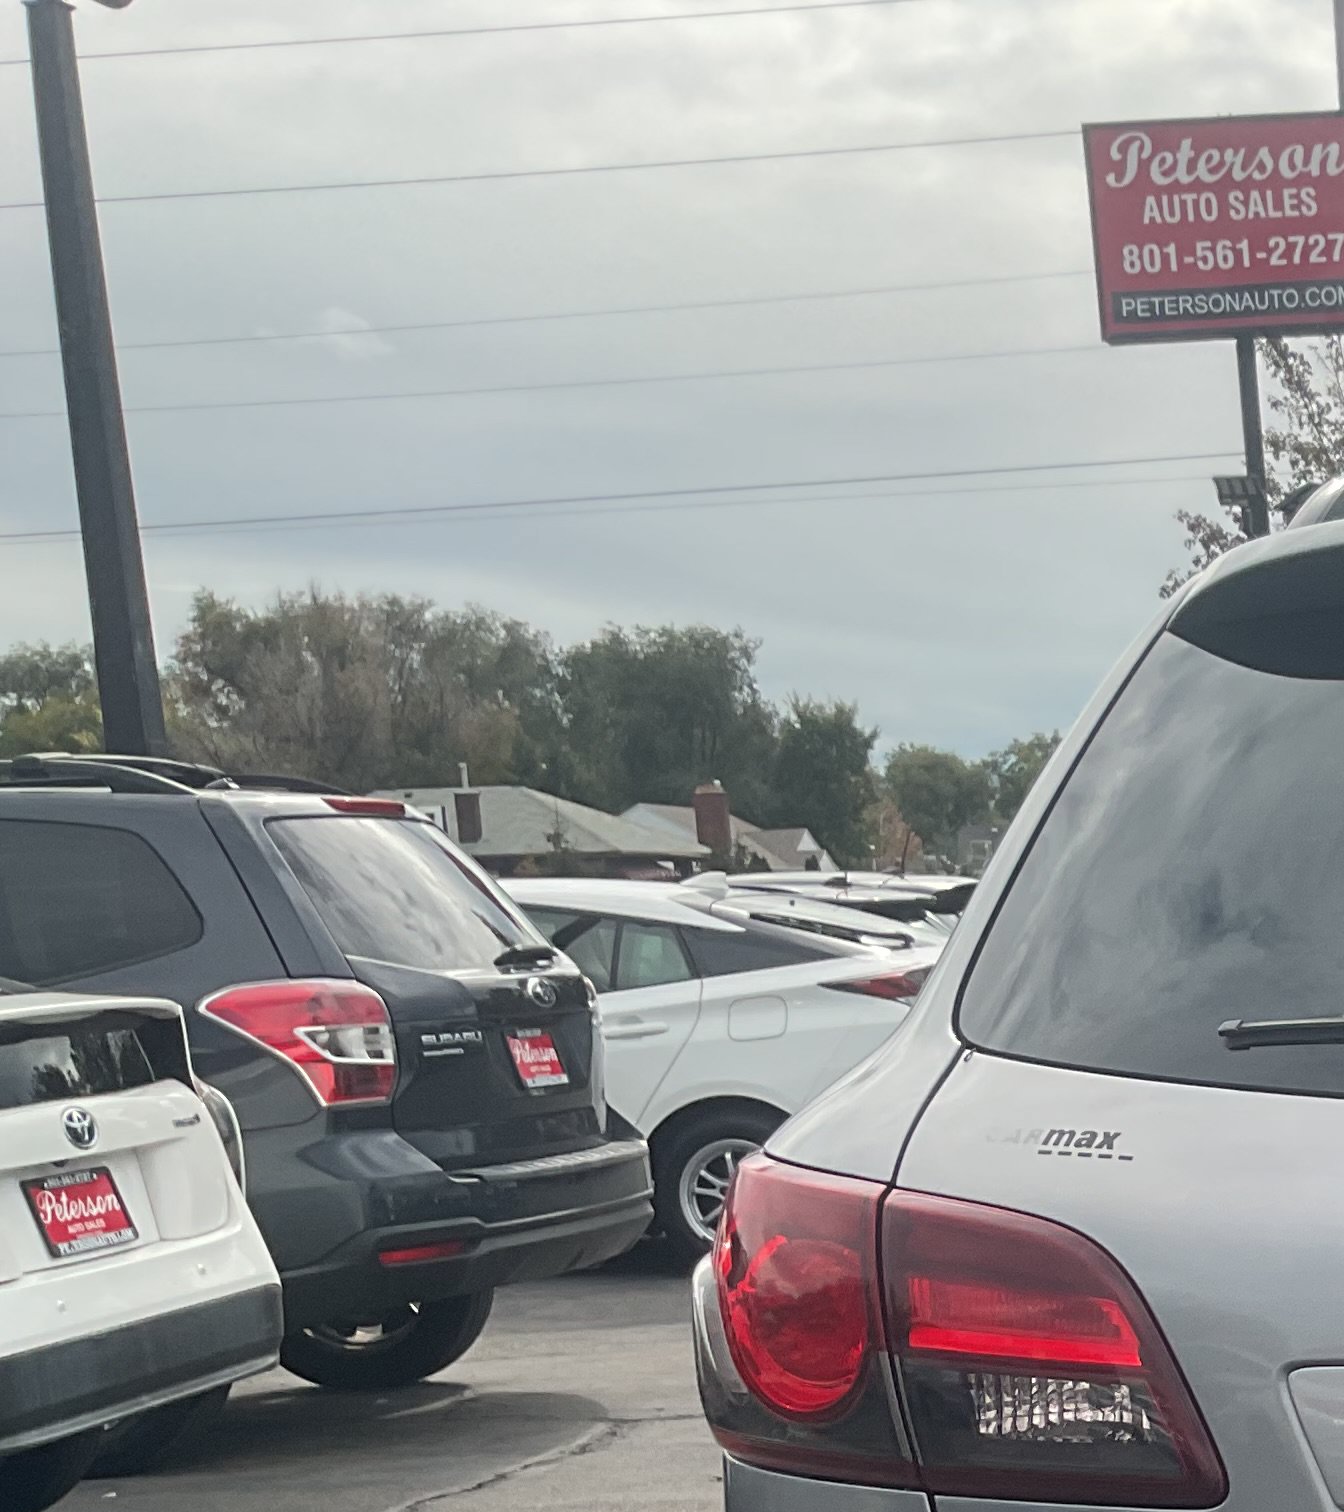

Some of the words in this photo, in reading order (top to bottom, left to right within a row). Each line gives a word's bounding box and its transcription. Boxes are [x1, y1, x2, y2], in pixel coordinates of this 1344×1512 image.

[1143, 192, 1218, 224] AUTO
[1229, 187, 1318, 221] SALES
[421, 1031, 483, 1046] SUBARU
[36, 1190, 121, 1224] Peterson
